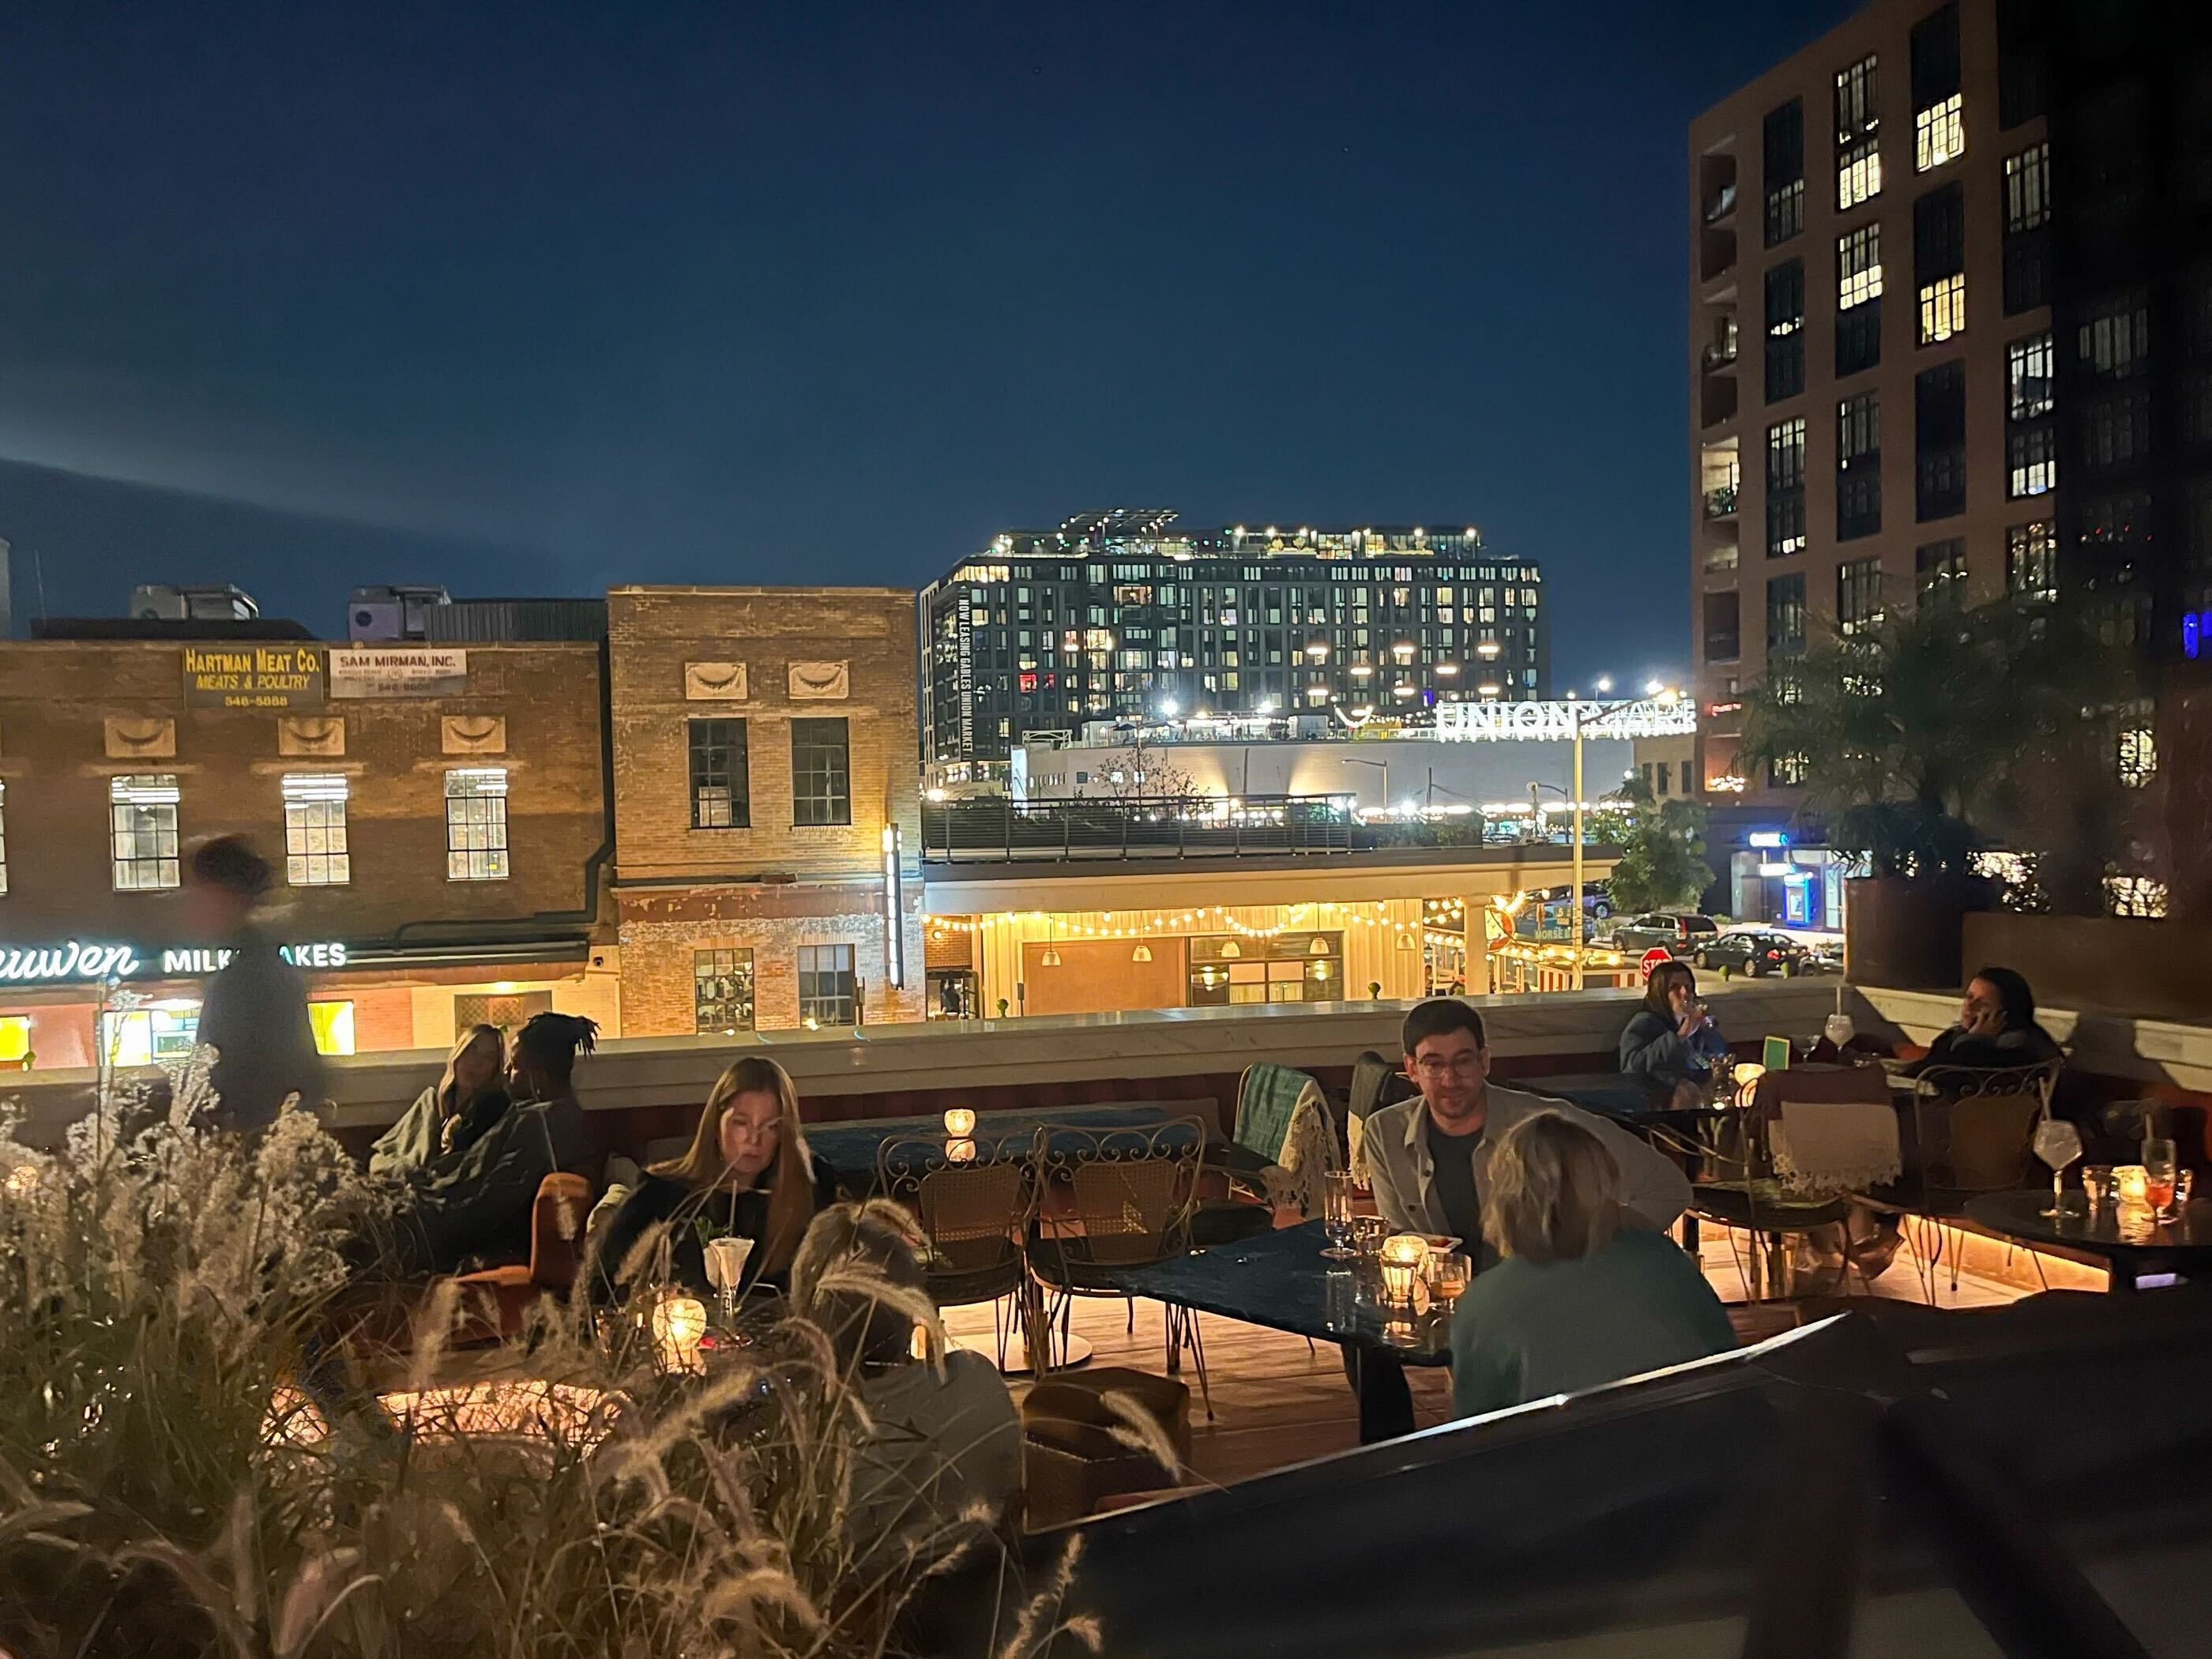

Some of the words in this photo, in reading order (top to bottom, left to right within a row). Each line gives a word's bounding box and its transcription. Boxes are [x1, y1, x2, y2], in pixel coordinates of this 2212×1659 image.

[958, 599, 970, 620] NOW
[959, 621, 971, 656] LEASING
[185, 648, 252, 672] HARTMAN
[256, 648, 292, 672] MEAT
[340, 656, 370, 668] SAM
[431, 655, 456, 668] INC.
[196, 675, 239, 690] MEATS
[243, 675, 253, 690] &
[258, 675, 310, 690] POULTRY
[960, 657, 972, 690] GABLES
[961, 690, 972, 717] UNION
[1436, 700, 1578, 741] UNION
[961, 718, 973, 753] MARKET
[1535, 928, 1563, 939] MORSE
[164, 942, 348, 973] MILKAKES
[1643, 958, 1669, 973] ST
